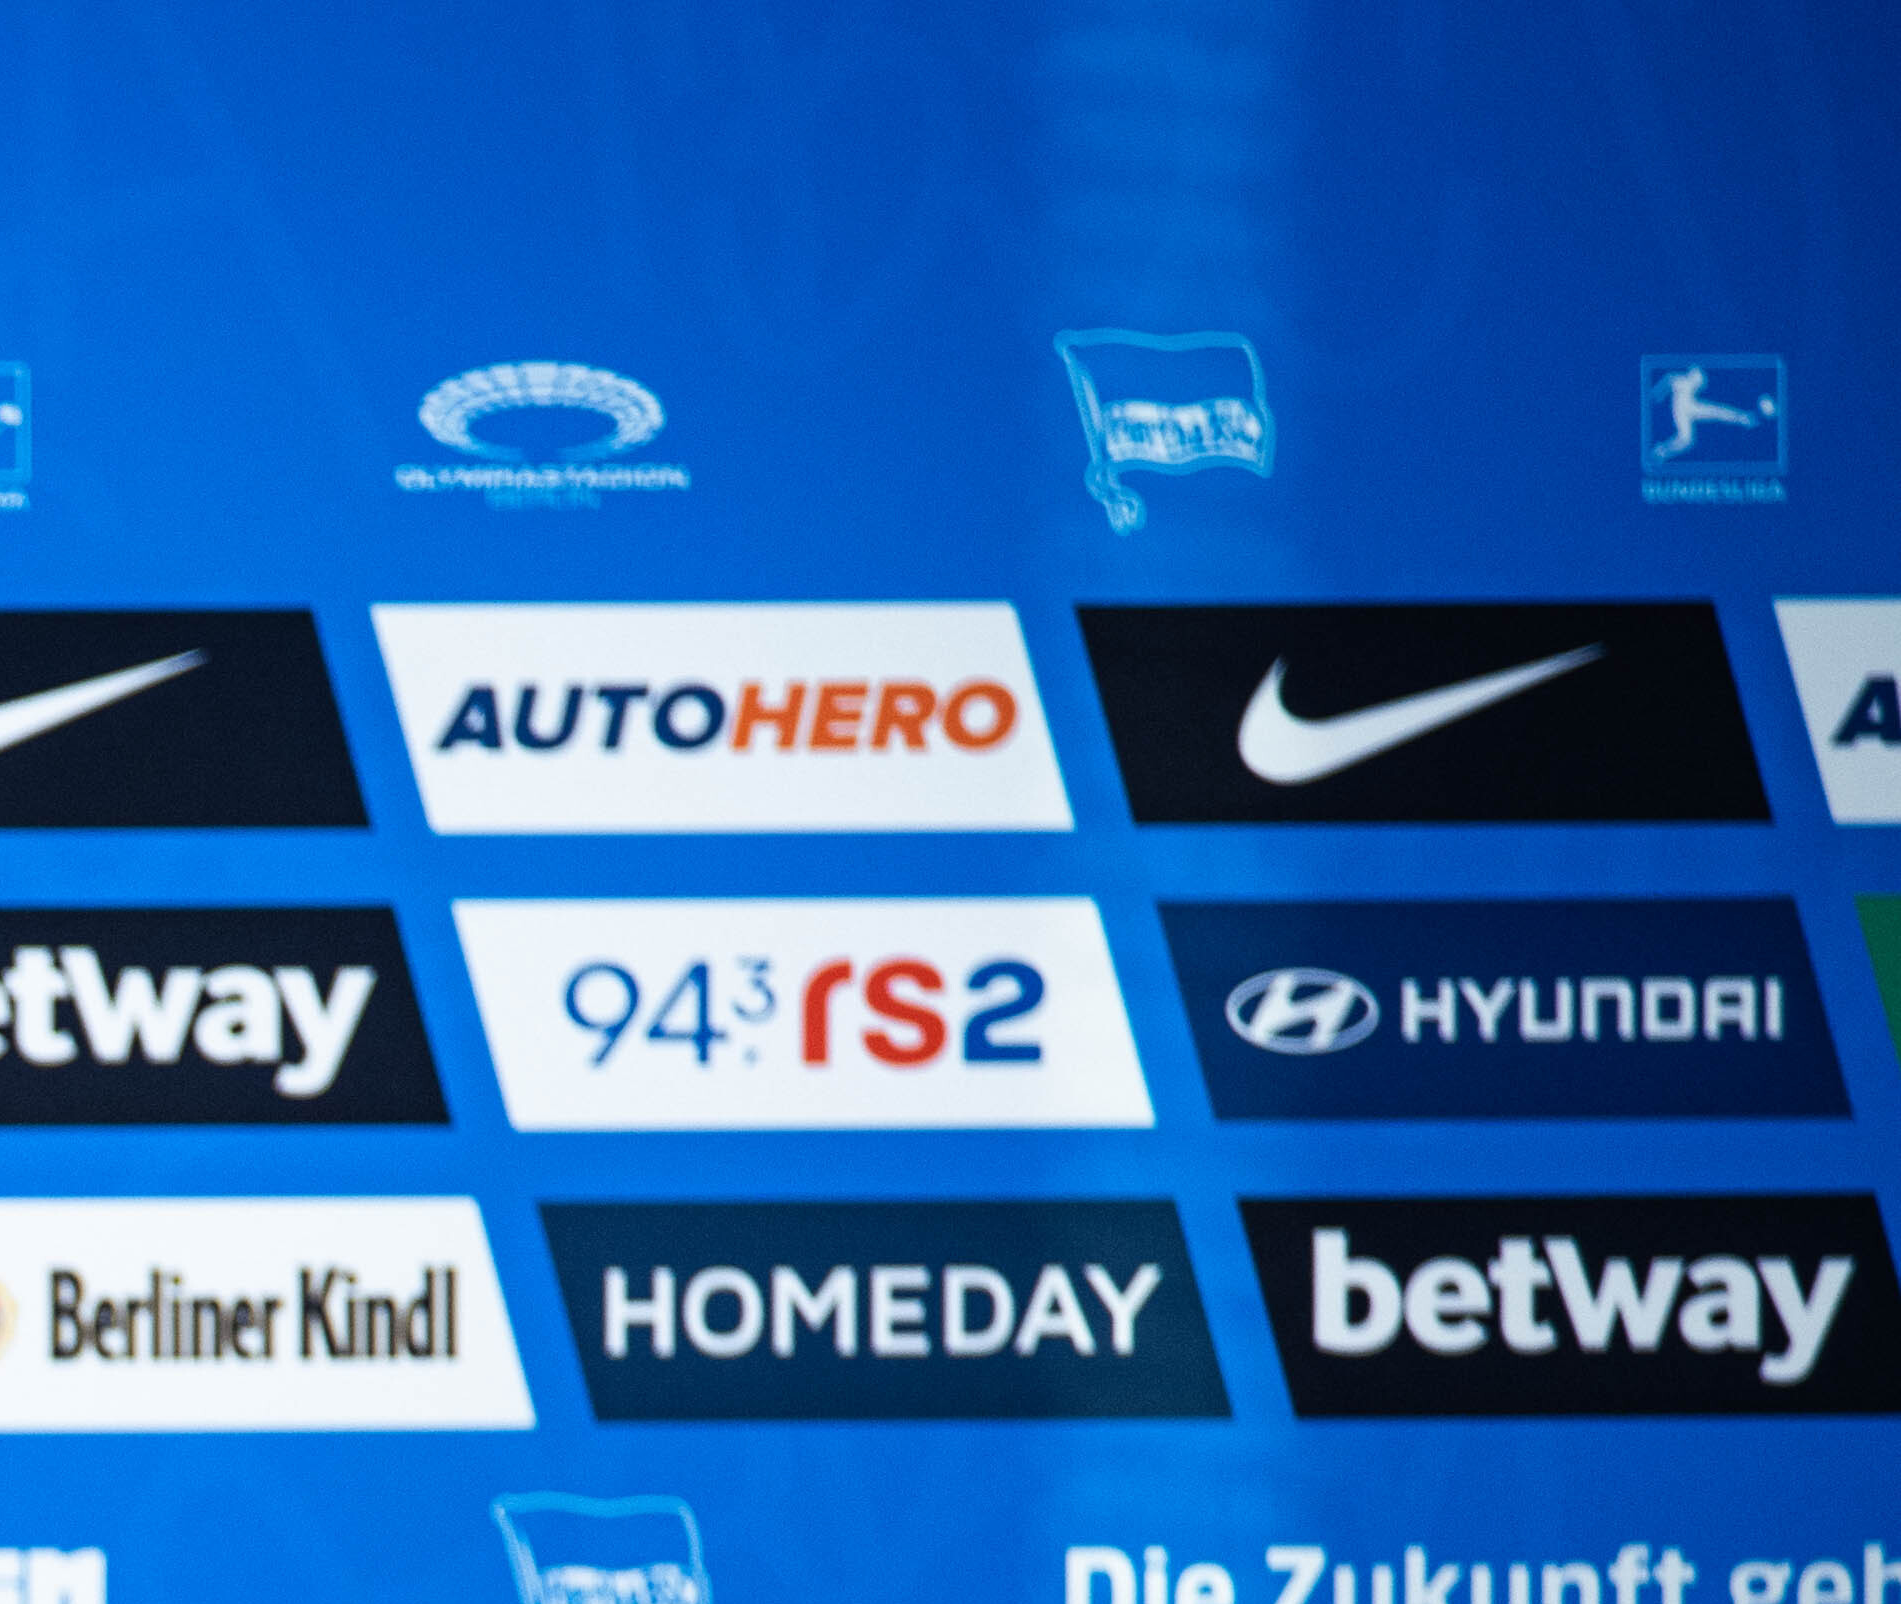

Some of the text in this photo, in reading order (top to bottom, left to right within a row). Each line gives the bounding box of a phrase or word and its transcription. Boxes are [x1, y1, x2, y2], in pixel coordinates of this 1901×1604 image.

[436, 681, 1016, 751] AUTOHERO
[802, 956, 1045, 1068] rs2
[1401, 975, 1783, 1041] HYUNDAI
[49, 1266, 460, 1362] Berliner Kindl
[602, 1263, 1161, 1358] HOMEDAY
[1311, 1228, 1855, 1384] betway
